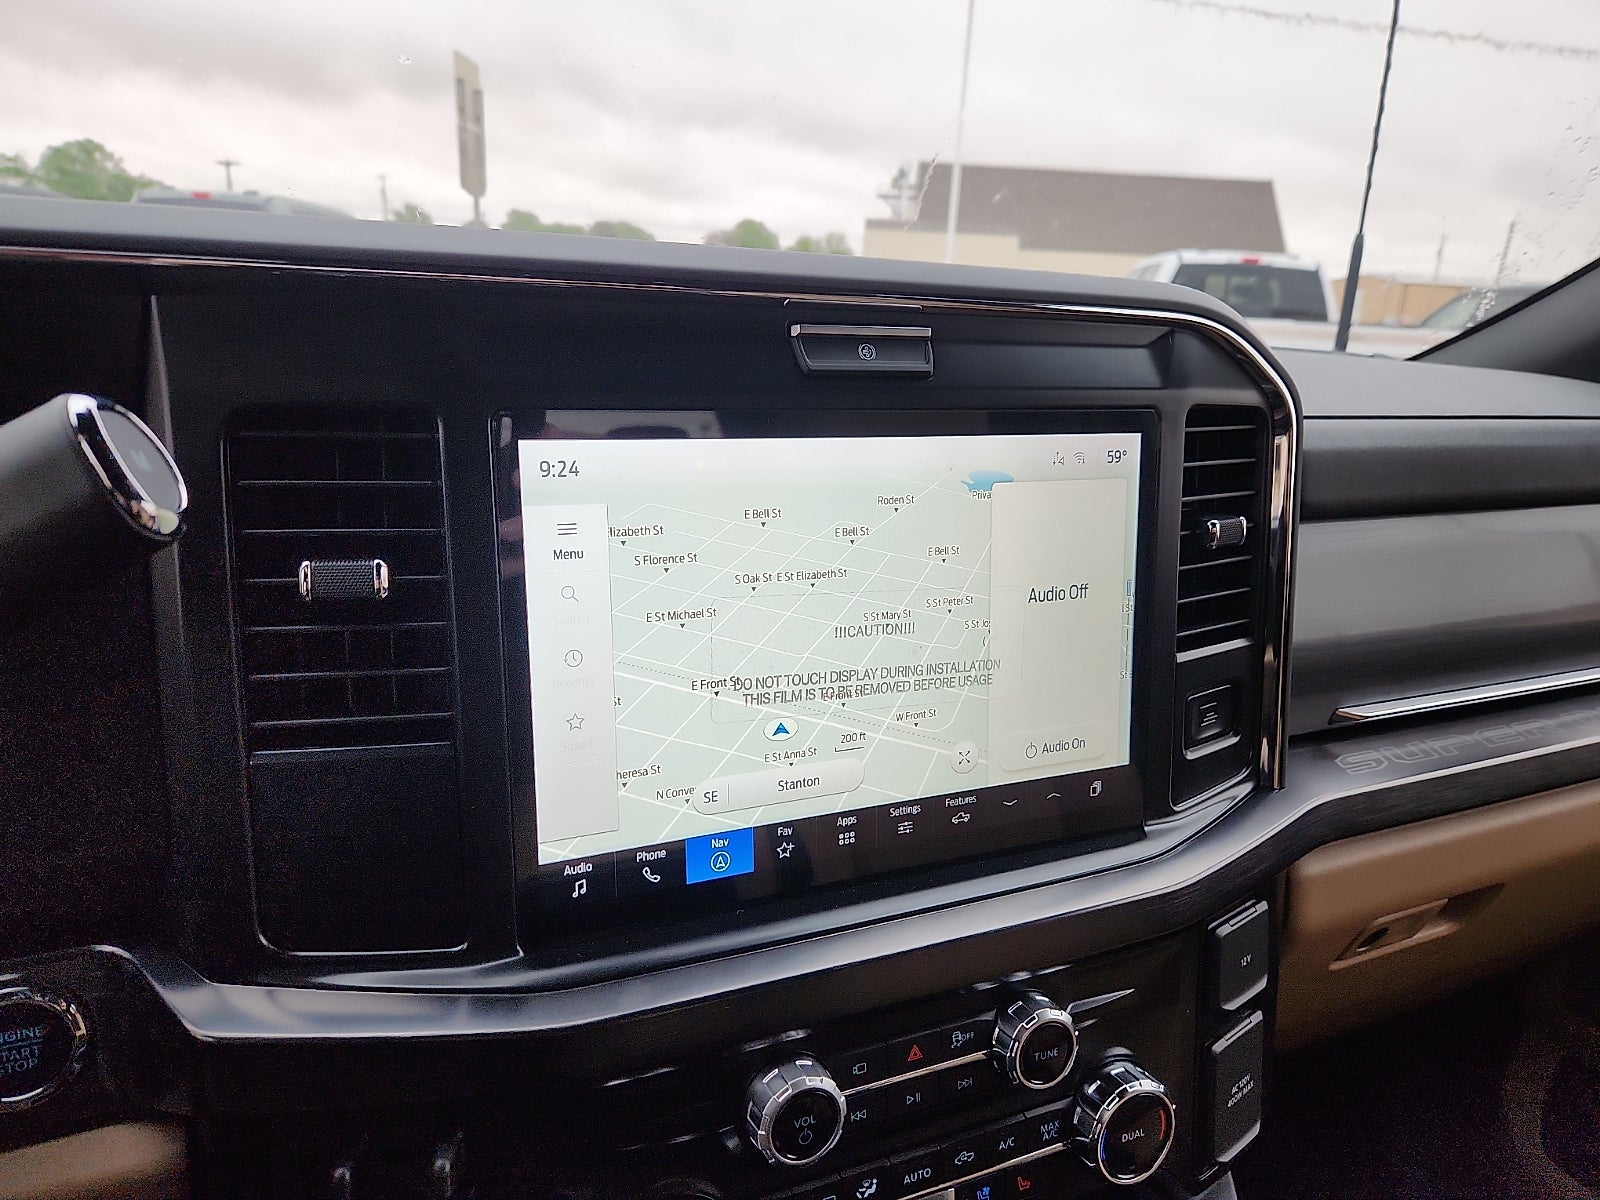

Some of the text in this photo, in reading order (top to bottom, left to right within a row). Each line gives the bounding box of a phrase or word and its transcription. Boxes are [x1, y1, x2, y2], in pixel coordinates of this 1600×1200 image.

[539, 460, 580, 478] 9:24
[877, 494, 915, 506] Roden St
[972, 490, 991, 500] Priva
[744, 508, 782, 519] E Bell St
[608, 524, 664, 538] lizabeth St
[835, 526, 870, 537] E Bell St
[553, 549, 584, 561] Menu
[928, 545, 960, 556] E Bell St
[634, 552, 698, 566] S Florence St
[735, 572, 773, 585] S Oak St
[777, 568, 848, 582] E St Elizabeth St
[1028, 583, 1089, 603] Audio Off
[926, 596, 974, 608] S St Peter St
[646, 608, 717, 622] E St Michael St
[863, 609, 912, 621] S St Mary St
[965, 621, 970, 629] S
[971, 620, 979, 628] St
[734, 659, 1001, 691] DO NOT TOUCH DISPLAY DURING INSTALLATION
[692, 676, 740, 691] E Front St
[743, 692, 771, 706] THIS
[773, 690, 802, 704] FILM
[805, 688, 816, 701] IS
[818, 687, 835, 700] TO
[855, 679, 911, 698] REMOVED
[913, 677, 956, 692] BEFORE
[958, 674, 993, 687] USAGE
[896, 709, 937, 722] W Front St
[840, 732, 867, 744] 200 ft
[1042, 738, 1086, 754] Audio On
[1334, 719, 1553, 775] SUPER
[764, 747, 818, 762] E St Anna St
[616, 764, 662, 780] heresa St
[777, 776, 820, 792] Stanton
[656, 787, 697, 801] N Conve
[703, 791, 719, 803] SE
[945, 795, 977, 807] Features
[889, 804, 921, 817] Settings
[837, 815, 857, 827] Apps
[777, 827, 794, 837] Fav
[711, 838, 730, 848] Nav
[636, 849, 667, 863] Phone
[563, 863, 593, 876] Audio
[961, 1031, 975, 1042] OFF
[1034, 1047, 1059, 1061] TUNE
[794, 1117, 816, 1128] VOL
[1040, 1120, 1060, 1133] MAX
[1042, 1131, 1059, 1141] A/C
[1121, 1129, 1146, 1142] DUAL
[999, 1137, 1015, 1150] A/C
[903, 1168, 932, 1185] AUTO
